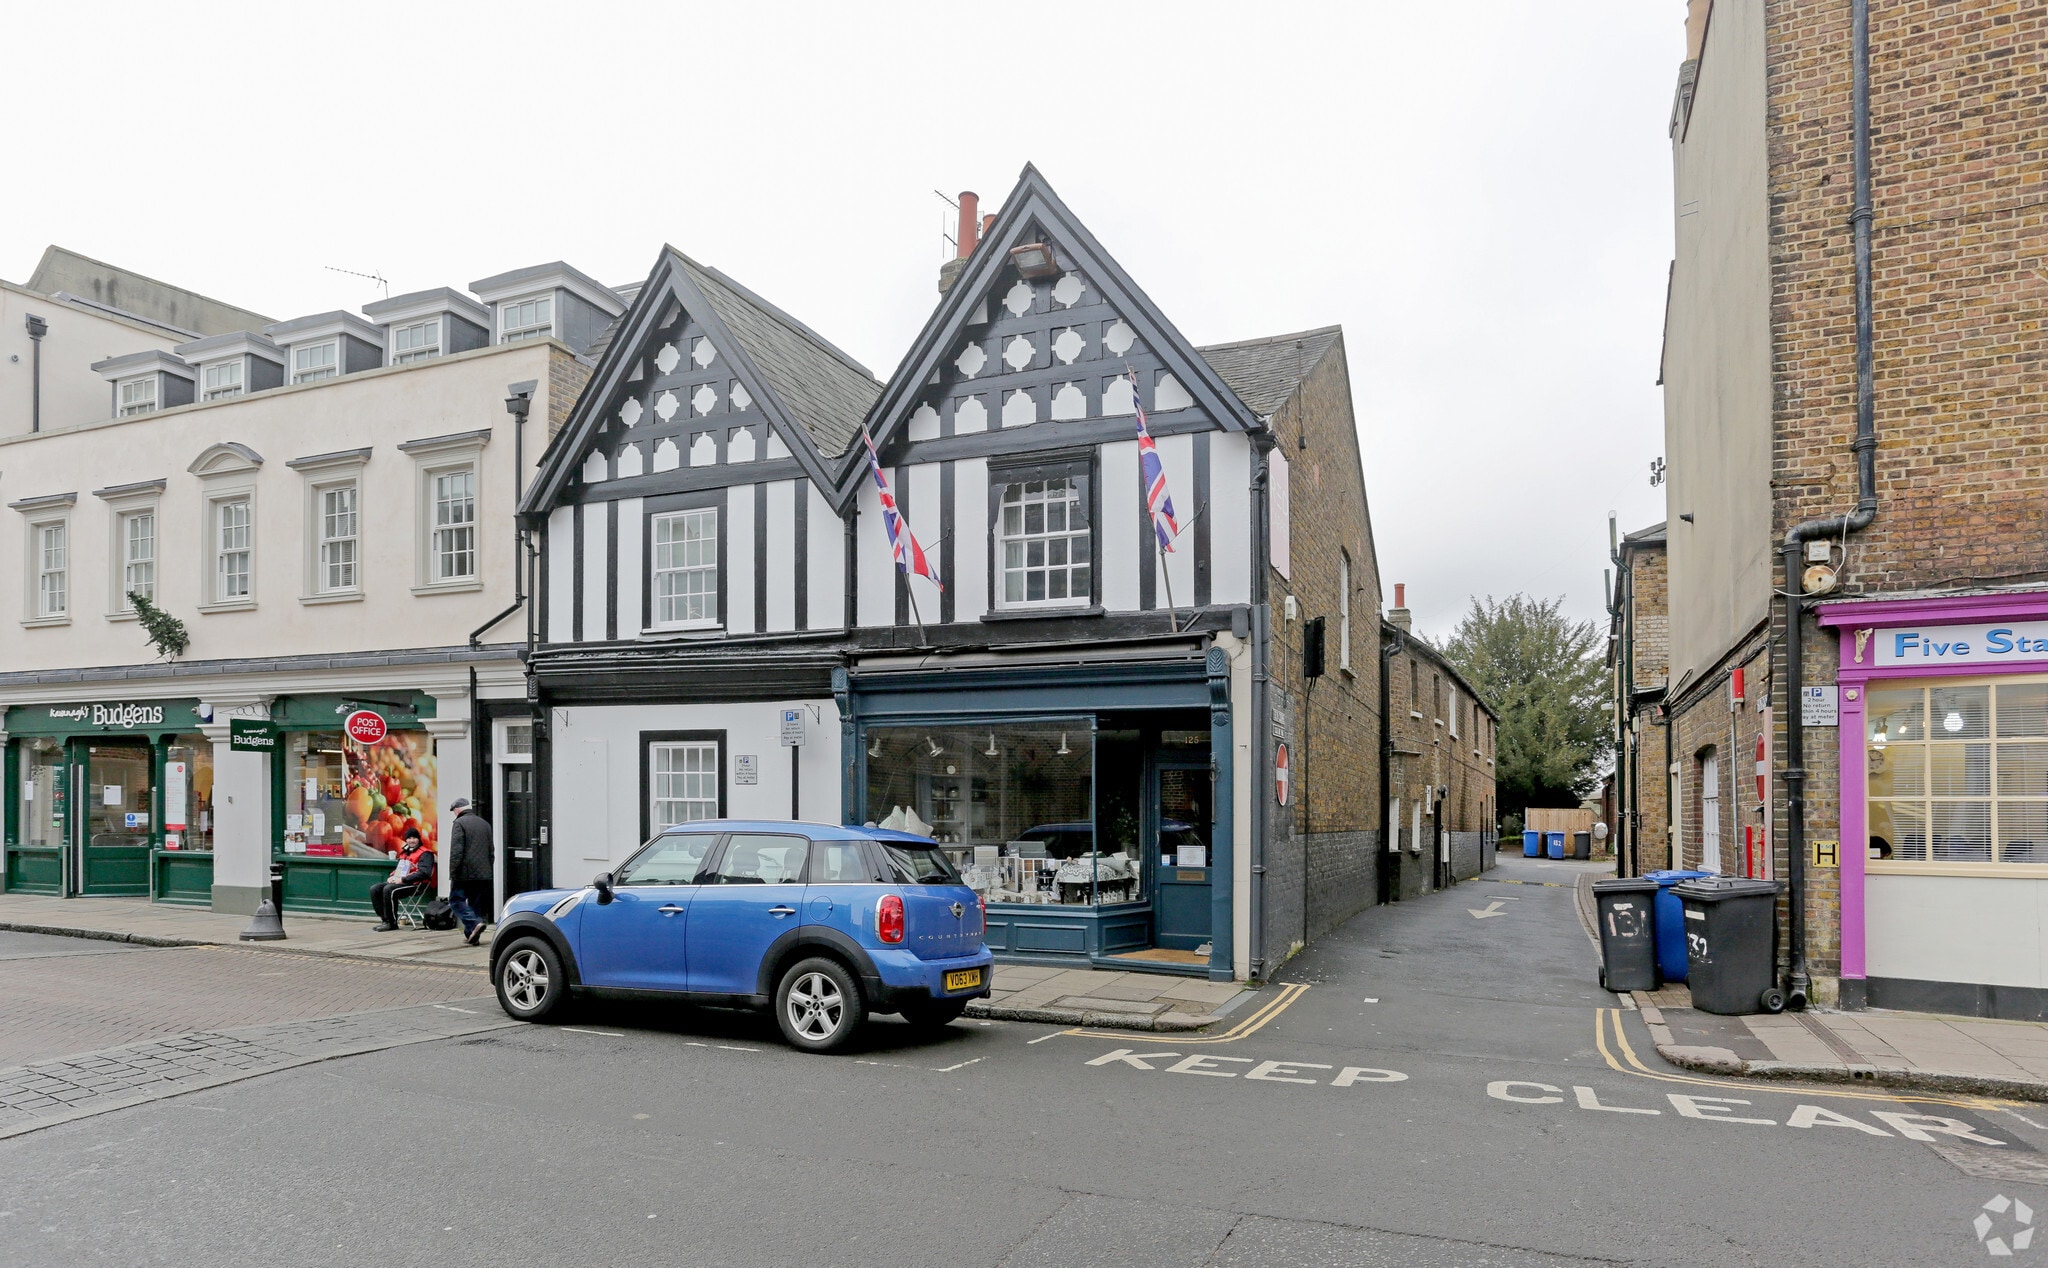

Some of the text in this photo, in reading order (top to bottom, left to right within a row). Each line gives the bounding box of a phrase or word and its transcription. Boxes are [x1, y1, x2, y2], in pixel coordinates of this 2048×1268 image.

[1895, 628, 2048, 657] Five Sta
[1813, 688, 1821, 697] P
[92, 703, 163, 728] Budgens
[357, 718, 378, 727] POST
[233, 734, 274, 746] Budgens
[351, 726, 381, 736] OFFICE
[1817, 844, 1835, 864] H
[1084, 1049, 1409, 1087] KEEP
[1487, 1081, 2007, 1145] CLEAR
